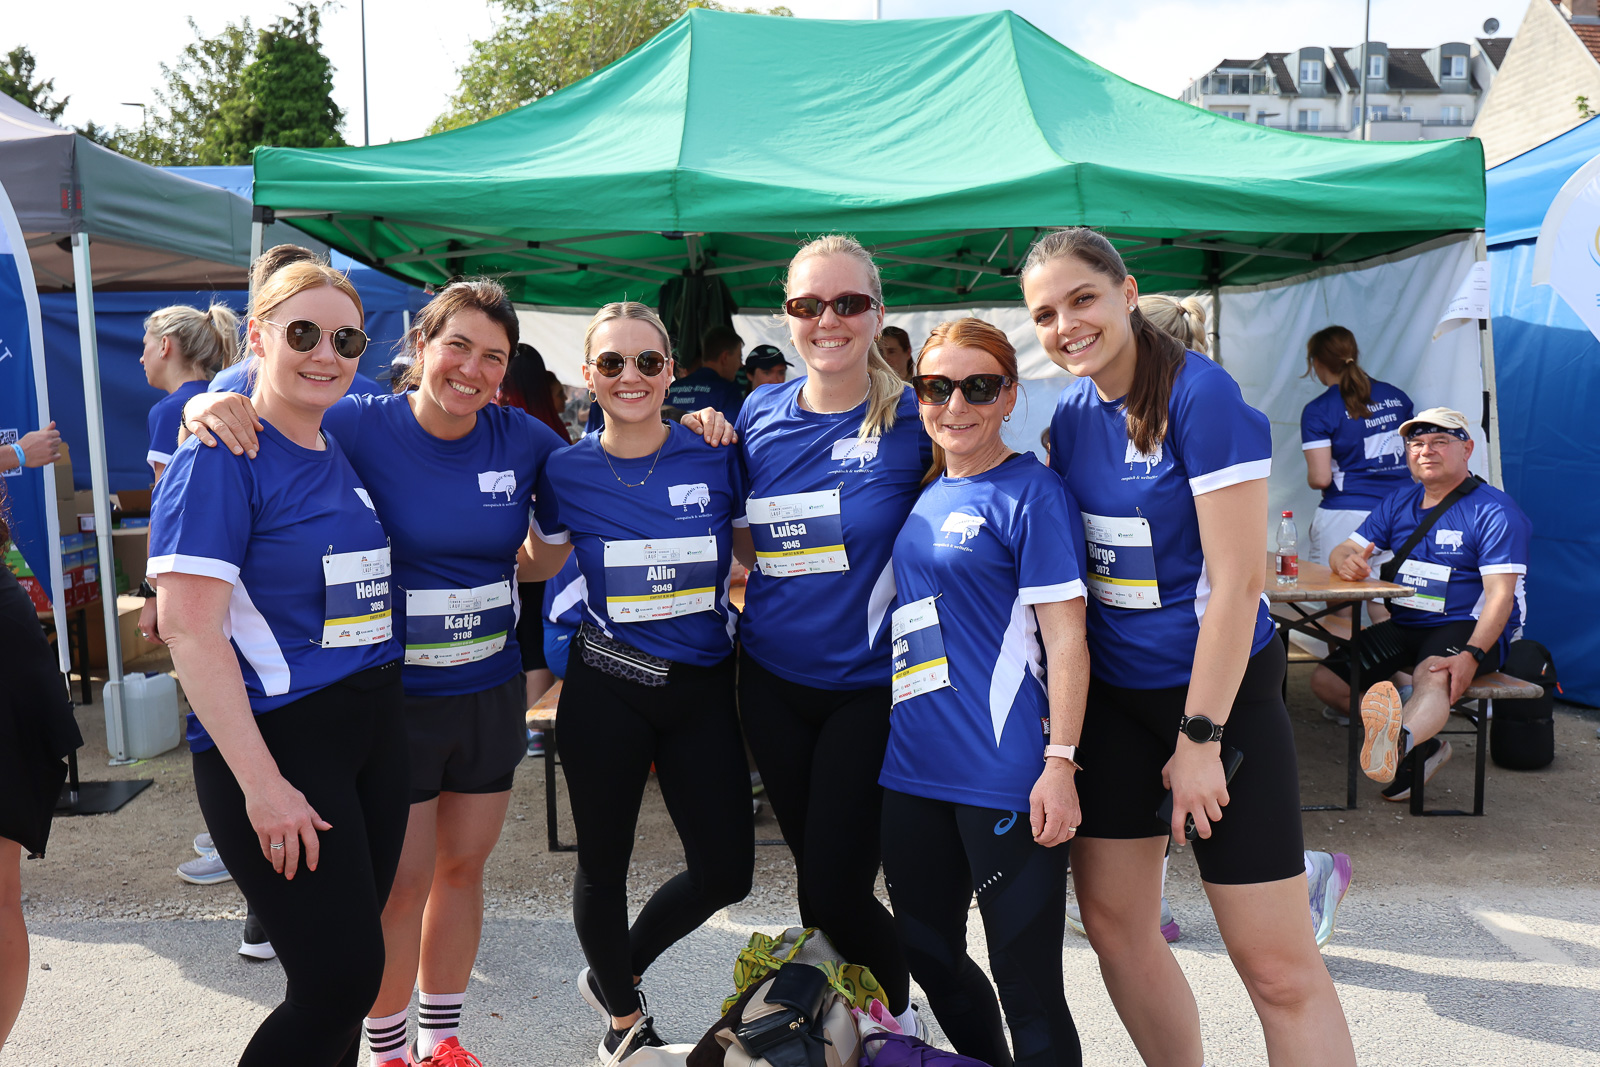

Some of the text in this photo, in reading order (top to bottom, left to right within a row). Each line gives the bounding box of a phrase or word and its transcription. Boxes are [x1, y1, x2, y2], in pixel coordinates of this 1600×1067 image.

[672, 396, 696, 404] Runners
[1365, 413, 1398, 429] Runners
[769, 522, 807, 538] Luisa
[782, 540, 801, 550] 3045
[1088, 542, 1116, 565] Birge
[646, 565, 677, 581] Alin
[1095, 565, 1111, 576] 3072
[1402, 574, 1428, 588] Martin
[355, 580, 389, 600] Helena
[651, 583, 673, 593] 3049
[370, 600, 385, 612] 3058
[444, 613, 482, 630] Katja
[452, 631, 473, 641] 3108
[894, 659, 907, 671] 3044
